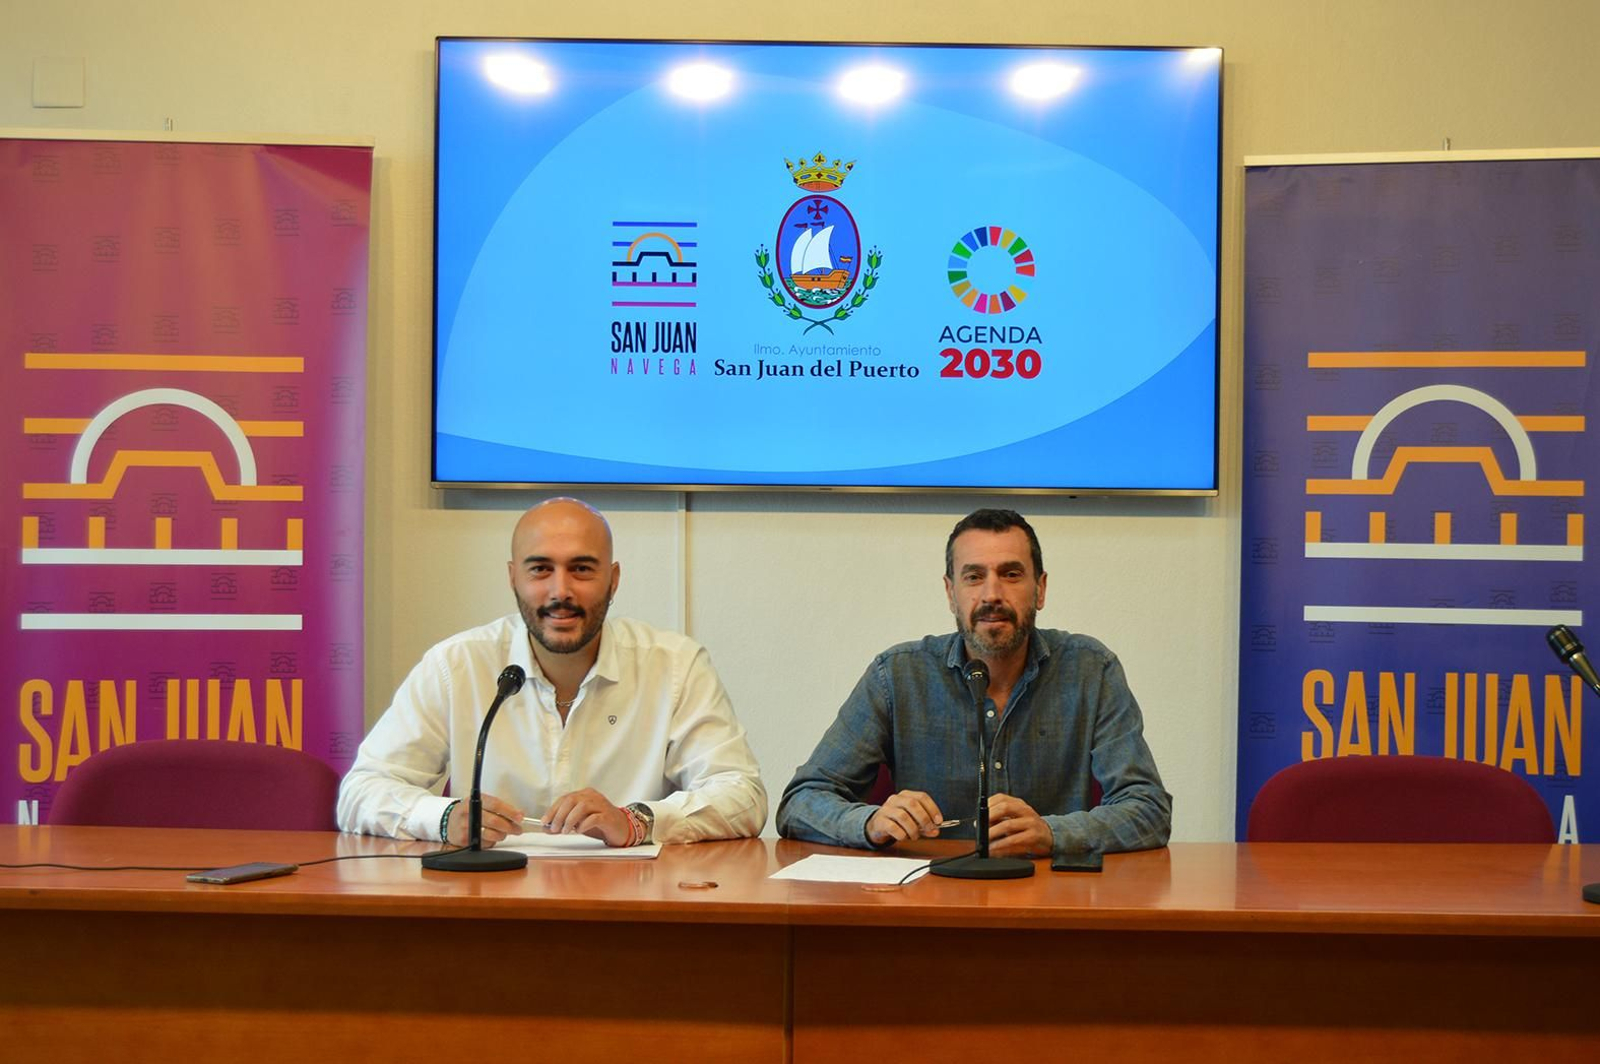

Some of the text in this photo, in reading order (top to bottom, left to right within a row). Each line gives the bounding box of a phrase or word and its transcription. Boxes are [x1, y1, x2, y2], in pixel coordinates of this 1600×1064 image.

[611, 321, 697, 353] SAN JUAN
[938, 325, 1043, 344] AGENDA
[753, 344, 882, 358] Ilmo. Ayuntamiento
[939, 347, 1042, 379] 2030
[610, 357, 697, 375] NAVEGA
[714, 359, 920, 381] San Juan del Puerto
[18, 678, 138, 783] SAN
[1300, 669, 1583, 777] SAN JUAN
